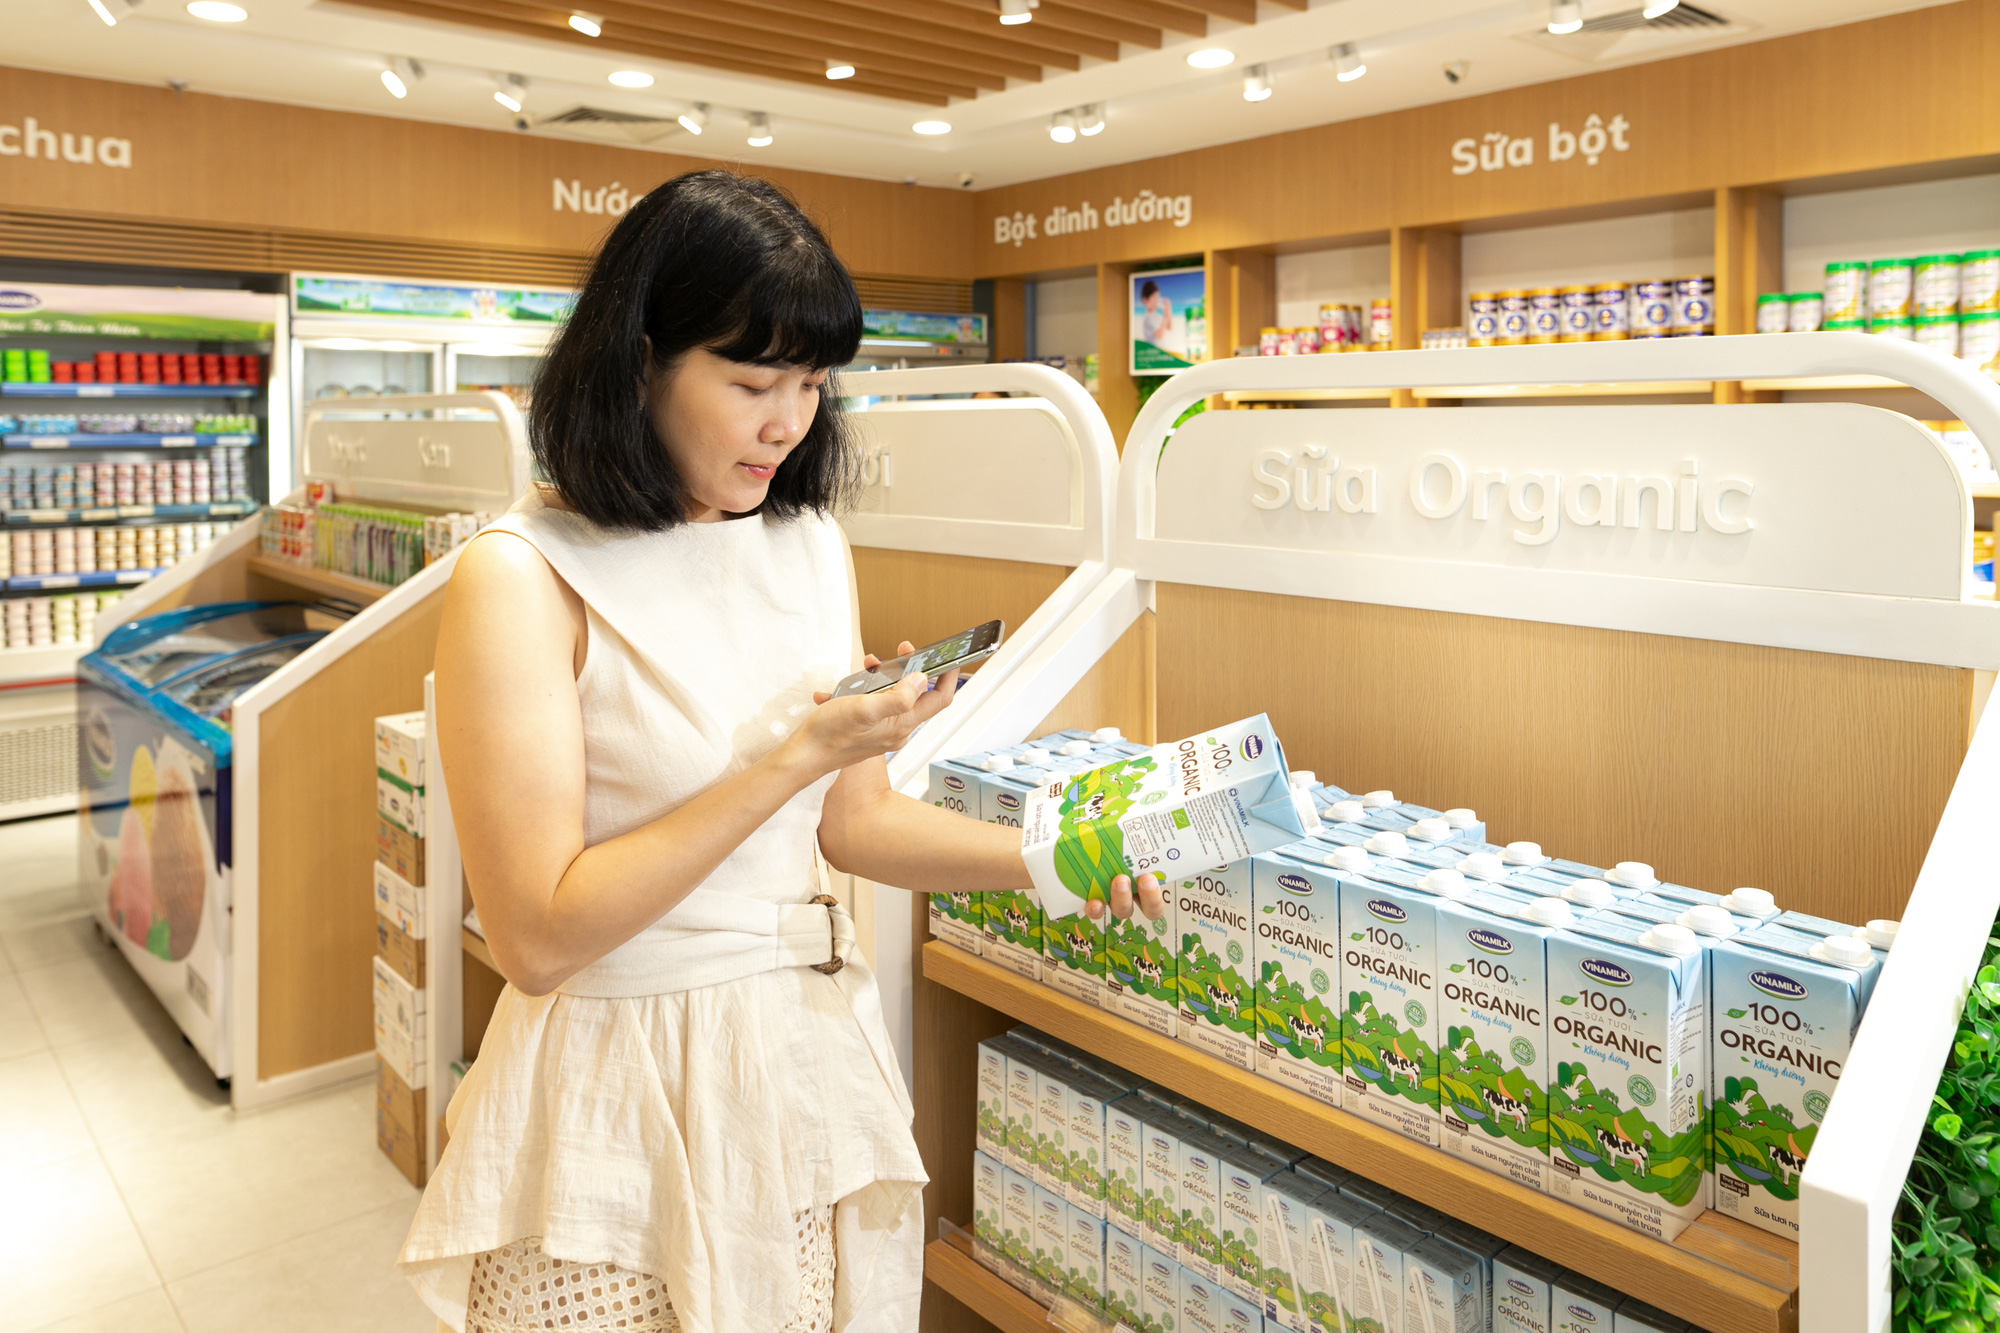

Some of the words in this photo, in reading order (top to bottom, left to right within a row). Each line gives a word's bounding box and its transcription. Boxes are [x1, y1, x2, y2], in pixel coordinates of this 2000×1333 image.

[1451, 132, 1534, 175] Sữa
[1549, 113, 1630, 165] bột
[994, 211, 1037, 246] Bột
[1044, 201, 1099, 237] dinh
[1104, 190, 1192, 228] dưỡng
[1250, 444, 1379, 515] Sữa
[1408, 454, 1756, 546] Organic
[1178, 740, 1201, 796] ORGANIC
[1233, 796, 1250, 828] VINAMILK
[1196, 876, 1232, 898] 100%
[1280, 876, 1311, 891] VINAMILK
[1180, 898, 1246, 931] ORGANIC
[1276, 900, 1317, 924] 100%
[1370, 902, 1404, 918] VINAMILK
[1258, 923, 1333, 958] ORGANIC
[1366, 926, 1412, 952] 100%
[1471, 932, 1510, 949] VINAMILK
[1346, 950, 1431, 990] ORGANIC
[1467, 958, 1519, 986] 100%
[1584, 961, 1629, 980] VINAMILK
[1754, 973, 1803, 994] VINAMILK
[1444, 983, 1540, 1026] ORGANIC
[1580, 990, 1637, 1020] 100%
[1748, 1002, 1814, 1035] 100%
[1554, 1016, 1662, 1064] ORGANIC
[1720, 1030, 1841, 1080] ORGANIC
[1182, 1180, 1216, 1202] ORGANIC
[1224, 1200, 1259, 1224] ORGANIC
[1498, 1305, 1545, 1333] ORGANIC
[1570, 1306, 1595, 1320] VINAMILK
